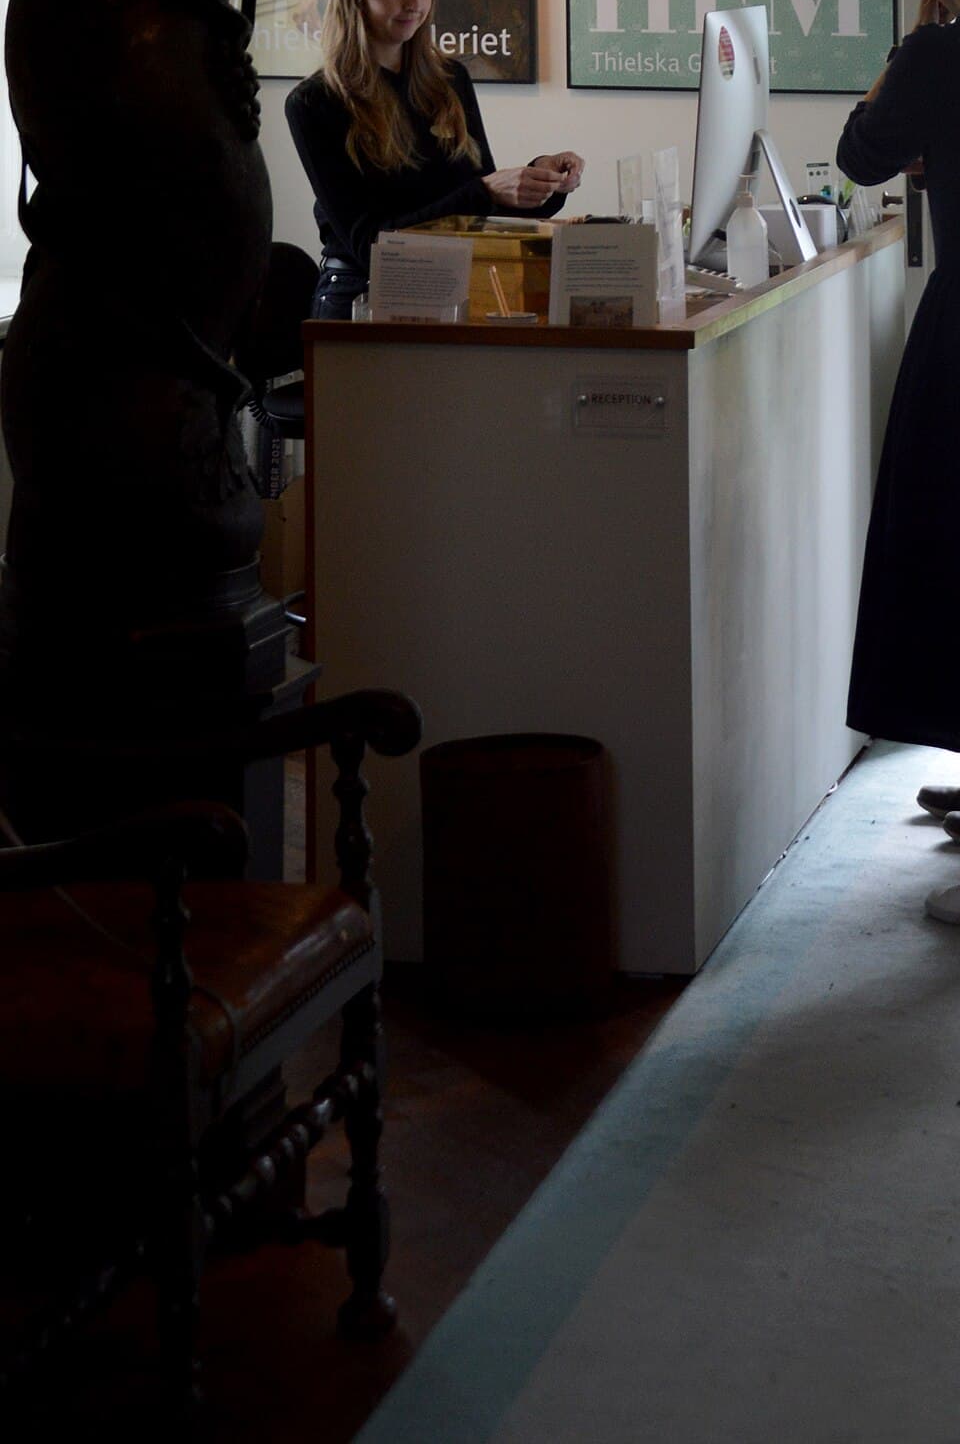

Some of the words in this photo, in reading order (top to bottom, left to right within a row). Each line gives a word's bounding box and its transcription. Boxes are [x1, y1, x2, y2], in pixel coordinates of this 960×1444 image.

[430, 24, 511, 56] leriet
[591, 52, 680, 73] Thielska
[591, 393, 652, 405] RECEPTION
